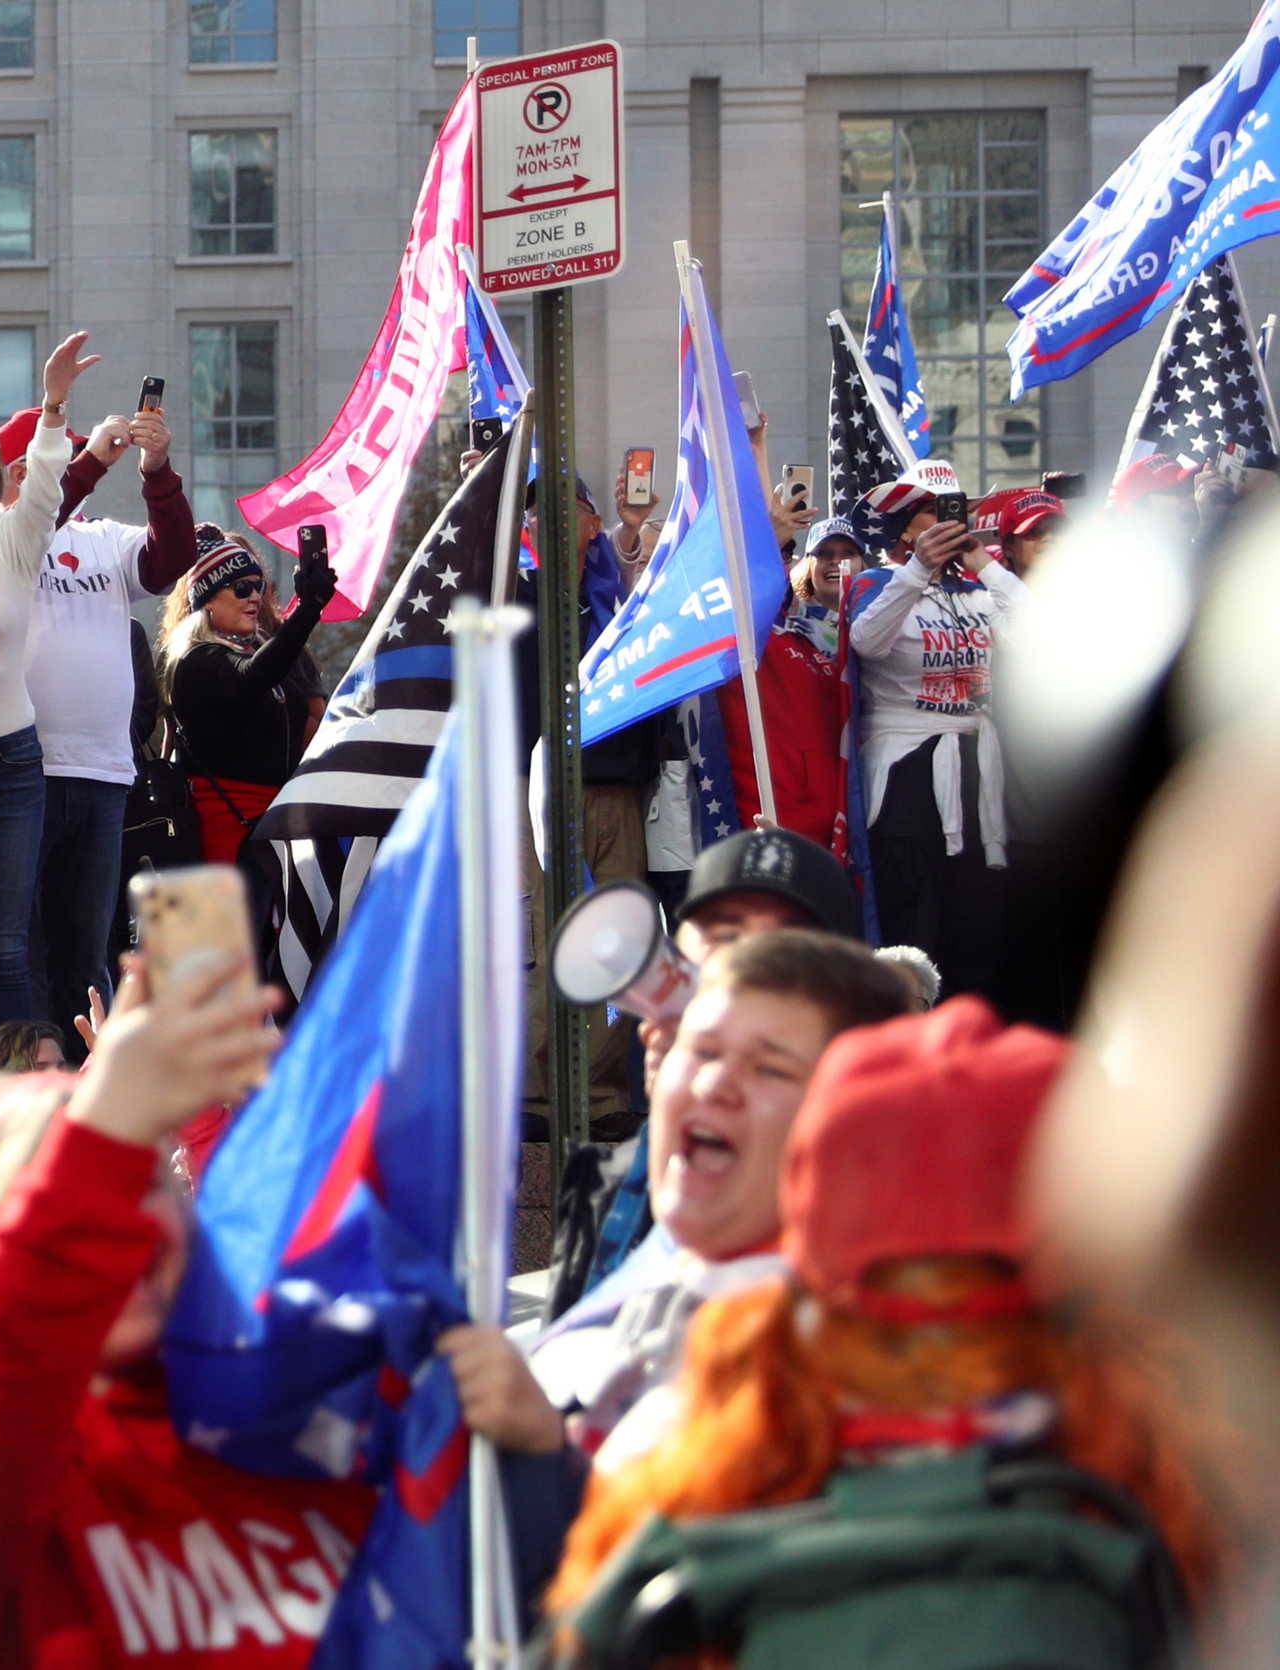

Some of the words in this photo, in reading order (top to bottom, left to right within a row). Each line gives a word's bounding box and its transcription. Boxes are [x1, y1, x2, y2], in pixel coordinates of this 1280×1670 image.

[478, 70, 530, 88] SPECIAL
[532, 60, 578, 78] PERMIT
[580, 51, 614, 68] ZONE
[515, 135, 581, 160] 7AM-7PM
[516, 153, 580, 177] MON-SAT
[529, 208, 569, 223] EXCEPT
[516, 225, 565, 247] ZONE
[574, 221, 586, 237] B
[507, 254, 546, 267] PERMIT
[547, 243, 594, 260] HOLDERS
[484, 276, 497, 289] IF
[500, 268, 552, 287] TOWED
[554, 262, 590, 278] CALL
[593, 255, 615, 270] 311
[45, 552, 55, 570] I
[207, 554, 249, 585] MAKE
[921, 627, 993, 652] MAG
[921, 648, 988, 668] MARCH
